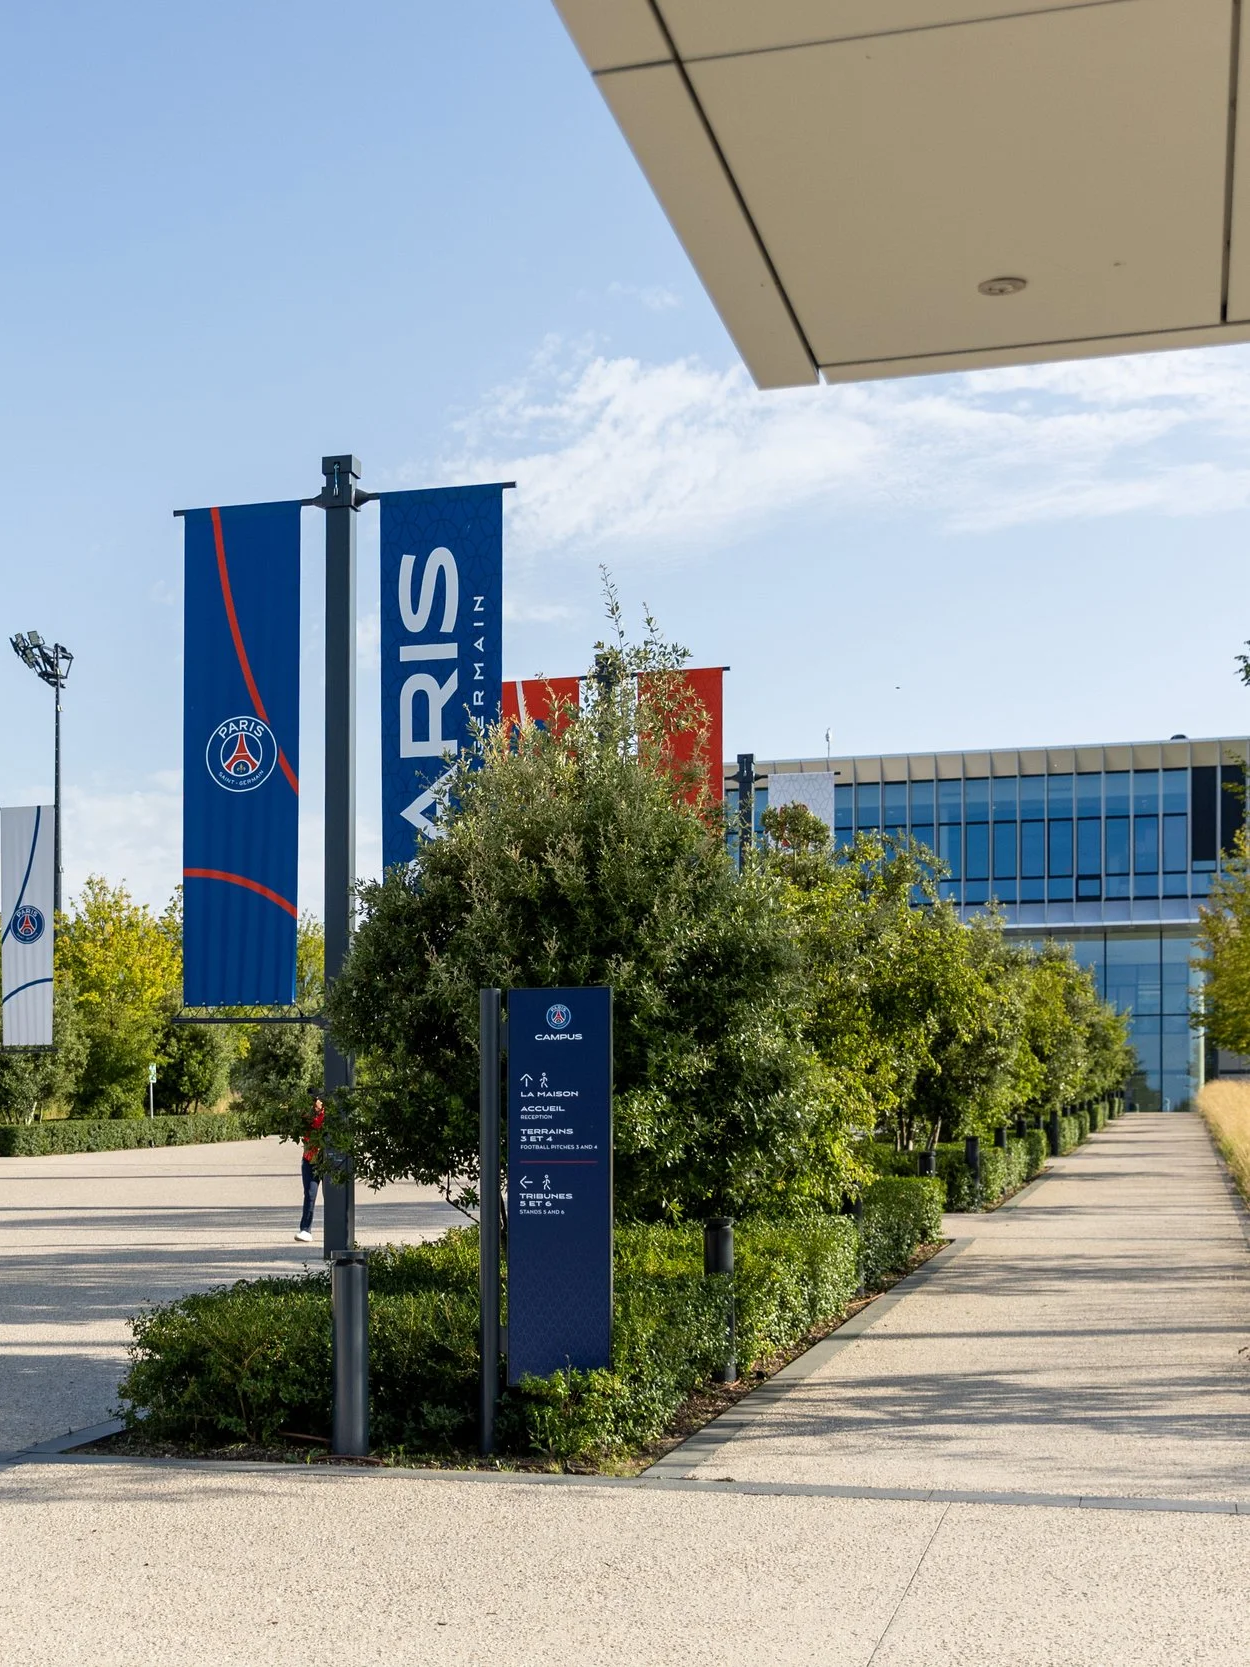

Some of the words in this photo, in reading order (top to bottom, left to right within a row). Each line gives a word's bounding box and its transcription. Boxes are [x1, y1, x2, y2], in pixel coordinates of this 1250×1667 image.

[398, 547, 459, 884] ARIS
[218, 719, 265, 739] PARIS
[16, 908, 39, 918] PARIS
[534, 1033, 583, 1041] CAMPUS
